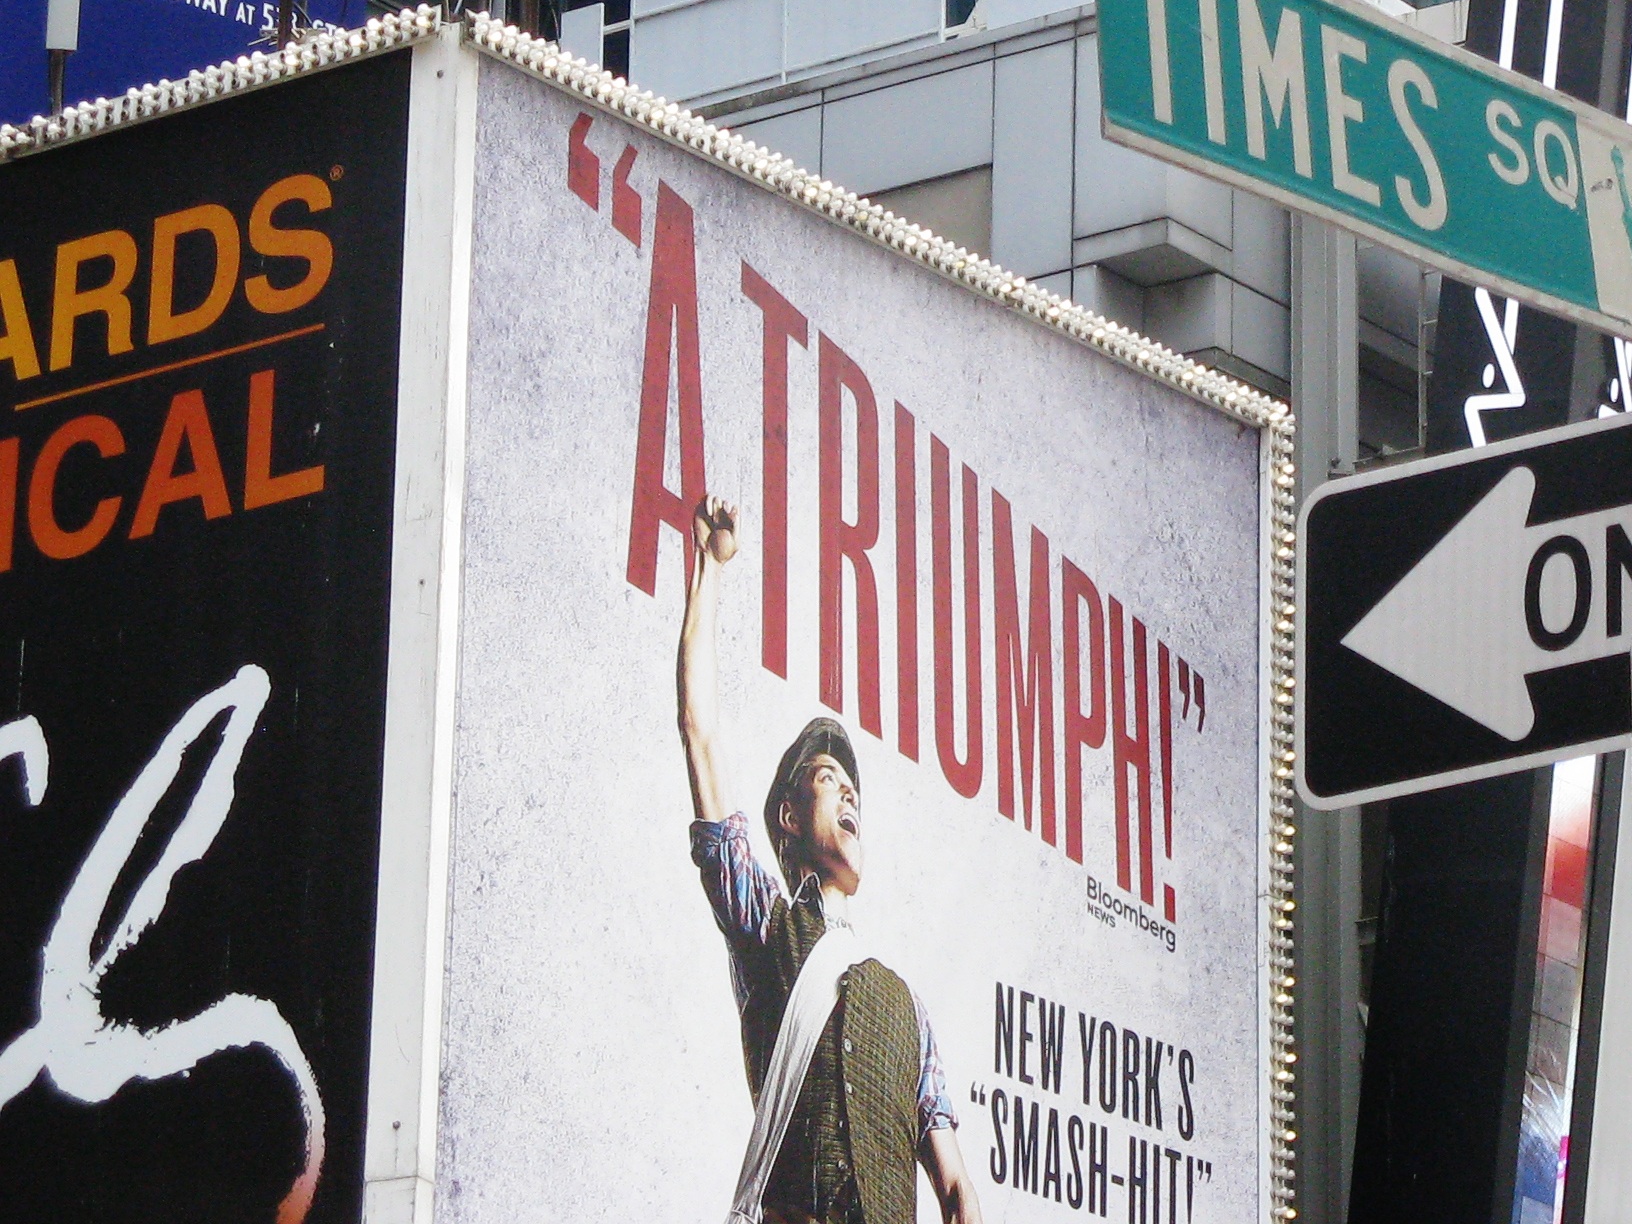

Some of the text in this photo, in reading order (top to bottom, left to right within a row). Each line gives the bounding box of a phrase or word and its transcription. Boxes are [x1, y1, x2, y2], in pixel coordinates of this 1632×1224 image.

[235, 2, 256, 26] AT
[1485, 99, 1579, 211] SQ
[1086, 875, 1177, 953] Bloomberg
[1086, 902, 1117, 928] NEWS
[994, 981, 1066, 1095] NEW
